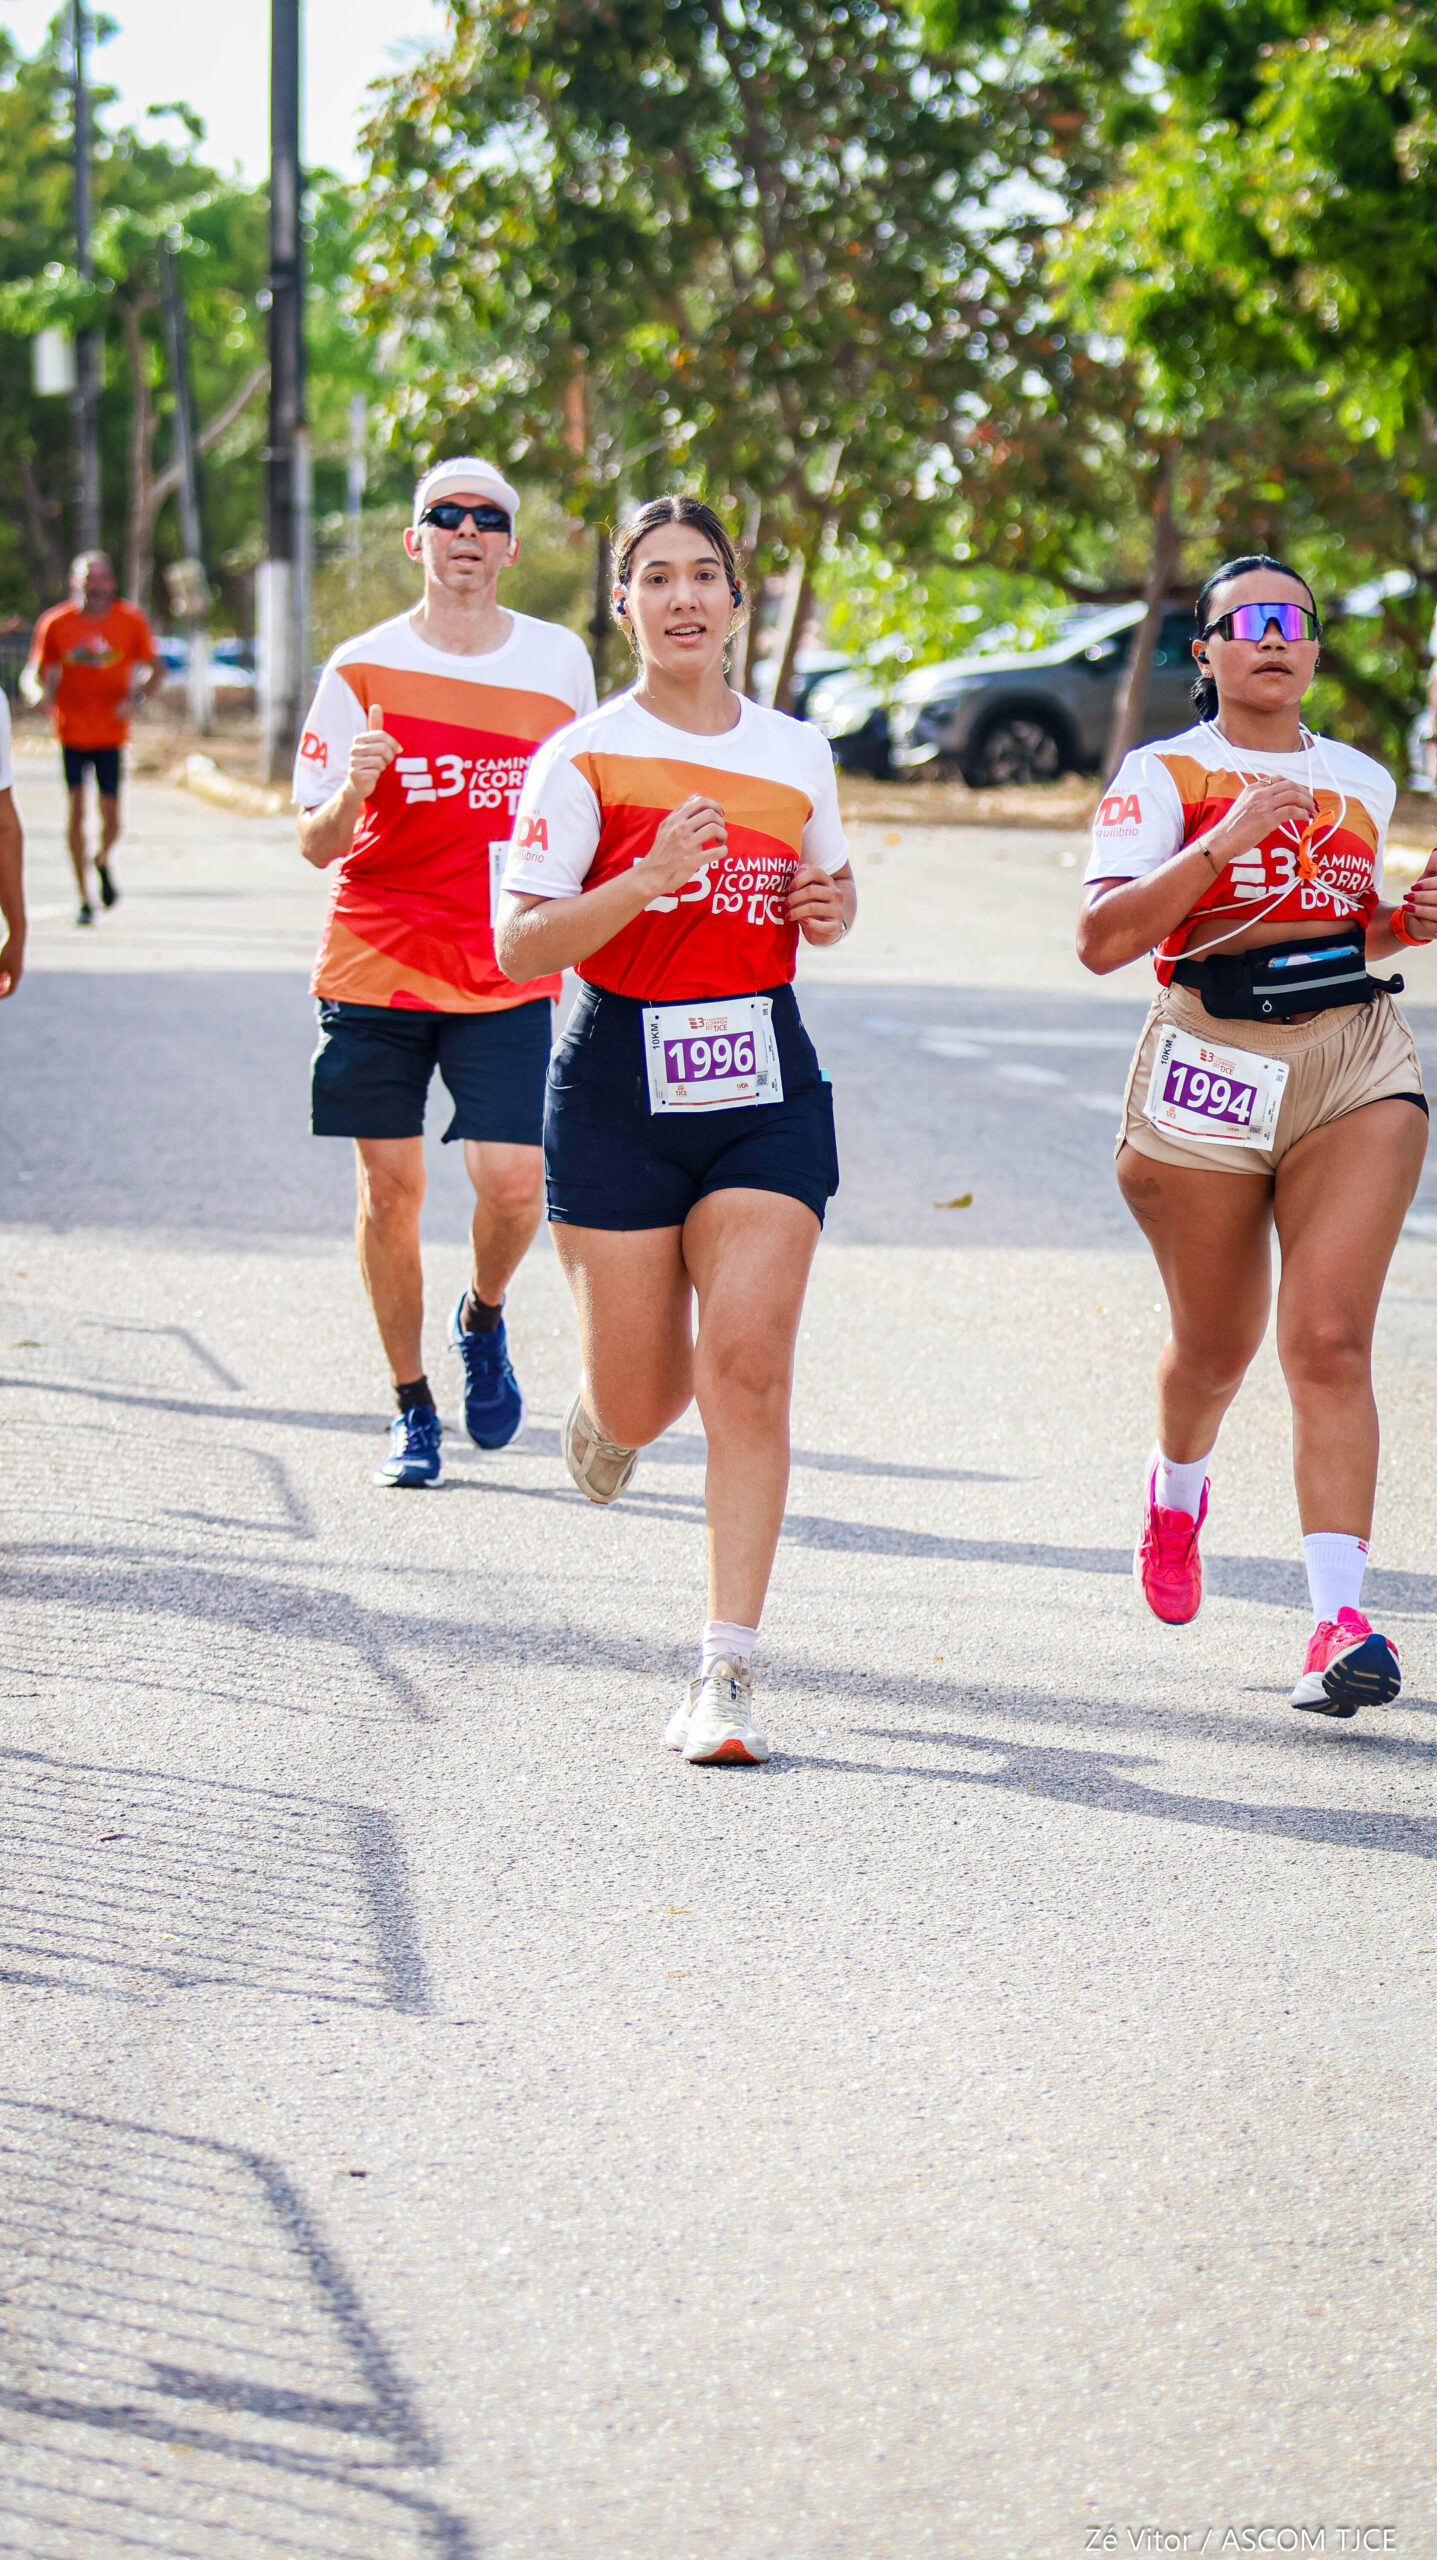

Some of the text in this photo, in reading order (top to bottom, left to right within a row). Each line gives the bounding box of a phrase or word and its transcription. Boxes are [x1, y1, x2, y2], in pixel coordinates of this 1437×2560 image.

[475, 757, 531, 772] CAMIN
[468, 771, 524, 790] /COR
[469, 788, 502, 809] DO
[723, 858, 799, 874] CAMINHAD
[1270, 847, 1298, 894] 3
[711, 893, 743, 914] DO
[1300, 887, 1330, 910] DO
[650, 1023, 660, 1050] 10KM
[668, 1034, 754, 1080] 1996
[1161, 1039, 1173, 1065] 10KM
[1172, 1066, 1252, 1123] 1994
